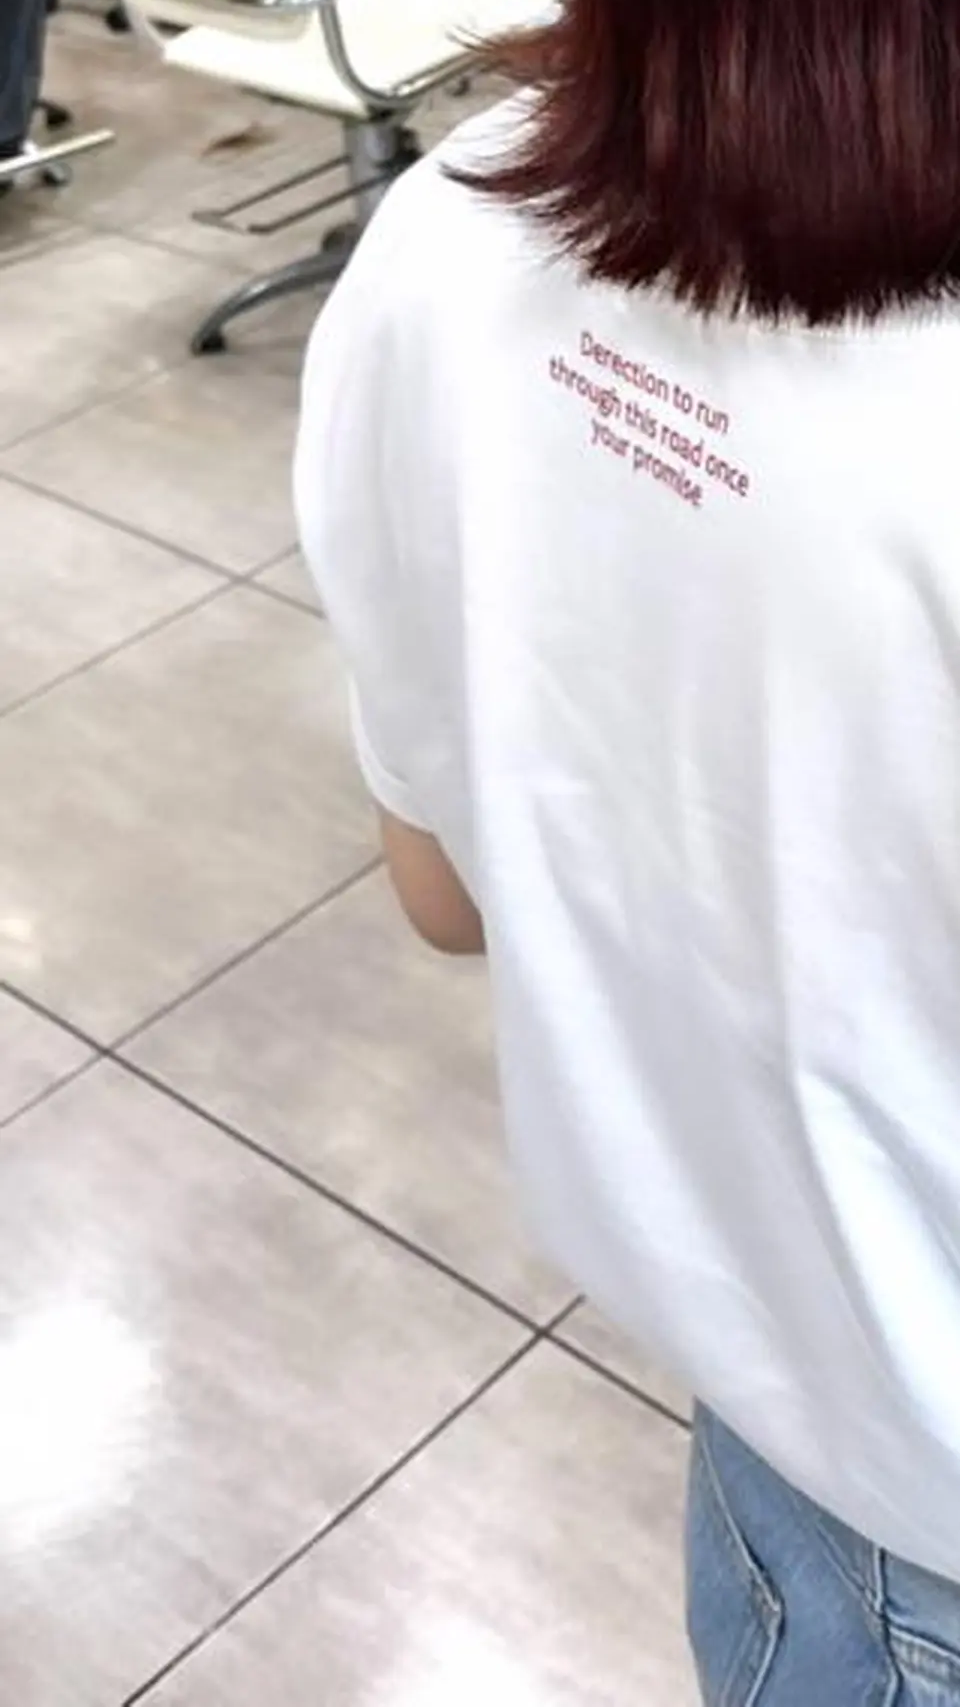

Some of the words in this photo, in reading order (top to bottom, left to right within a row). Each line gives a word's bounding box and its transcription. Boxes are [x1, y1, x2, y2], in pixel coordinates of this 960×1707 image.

[549, 355, 622, 418] through
[625, 399, 657, 439] this
[661, 423, 703, 467] road
[705, 454, 749, 497] once
[581, 331, 669, 402] Derection
[673, 384, 692, 414] to
[696, 400, 730, 435] run
[591, 417, 629, 457] your
[633, 446, 701, 507] promise
